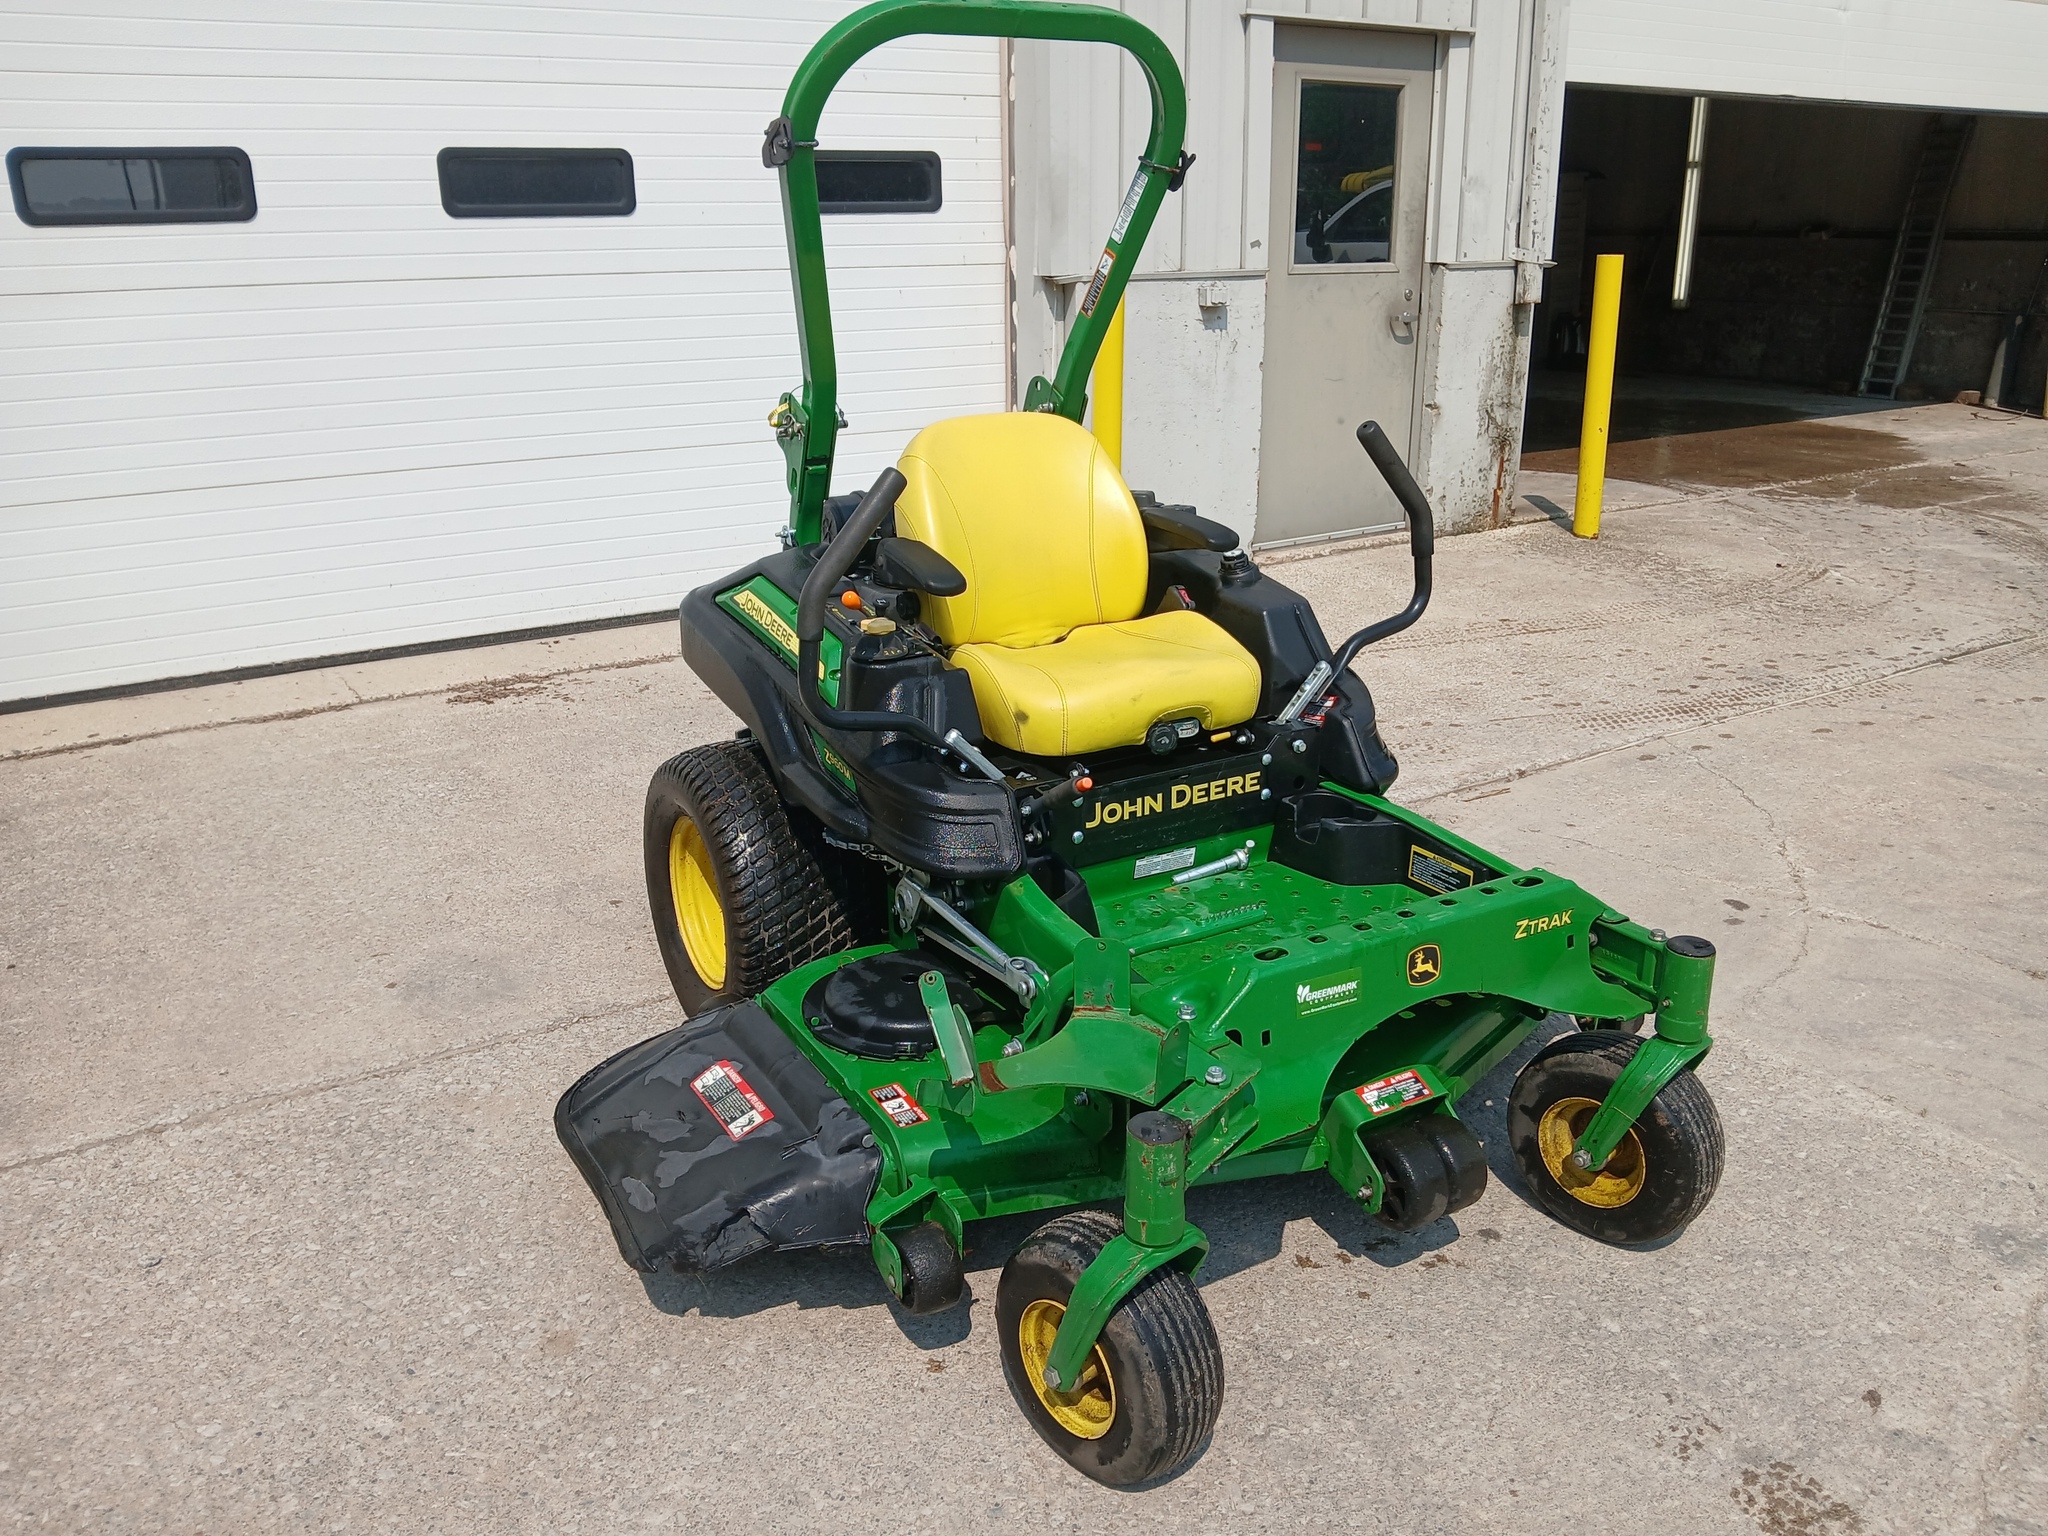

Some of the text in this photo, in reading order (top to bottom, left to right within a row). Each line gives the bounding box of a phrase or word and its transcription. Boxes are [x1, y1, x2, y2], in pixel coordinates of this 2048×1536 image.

[741, 594, 793, 647] JOHN DEERE
[1085, 771, 1261, 828] JOHN DEERE
[1514, 910, 1573, 939] ZTRAK
[1306, 981, 1358, 1001] GREENMARK
